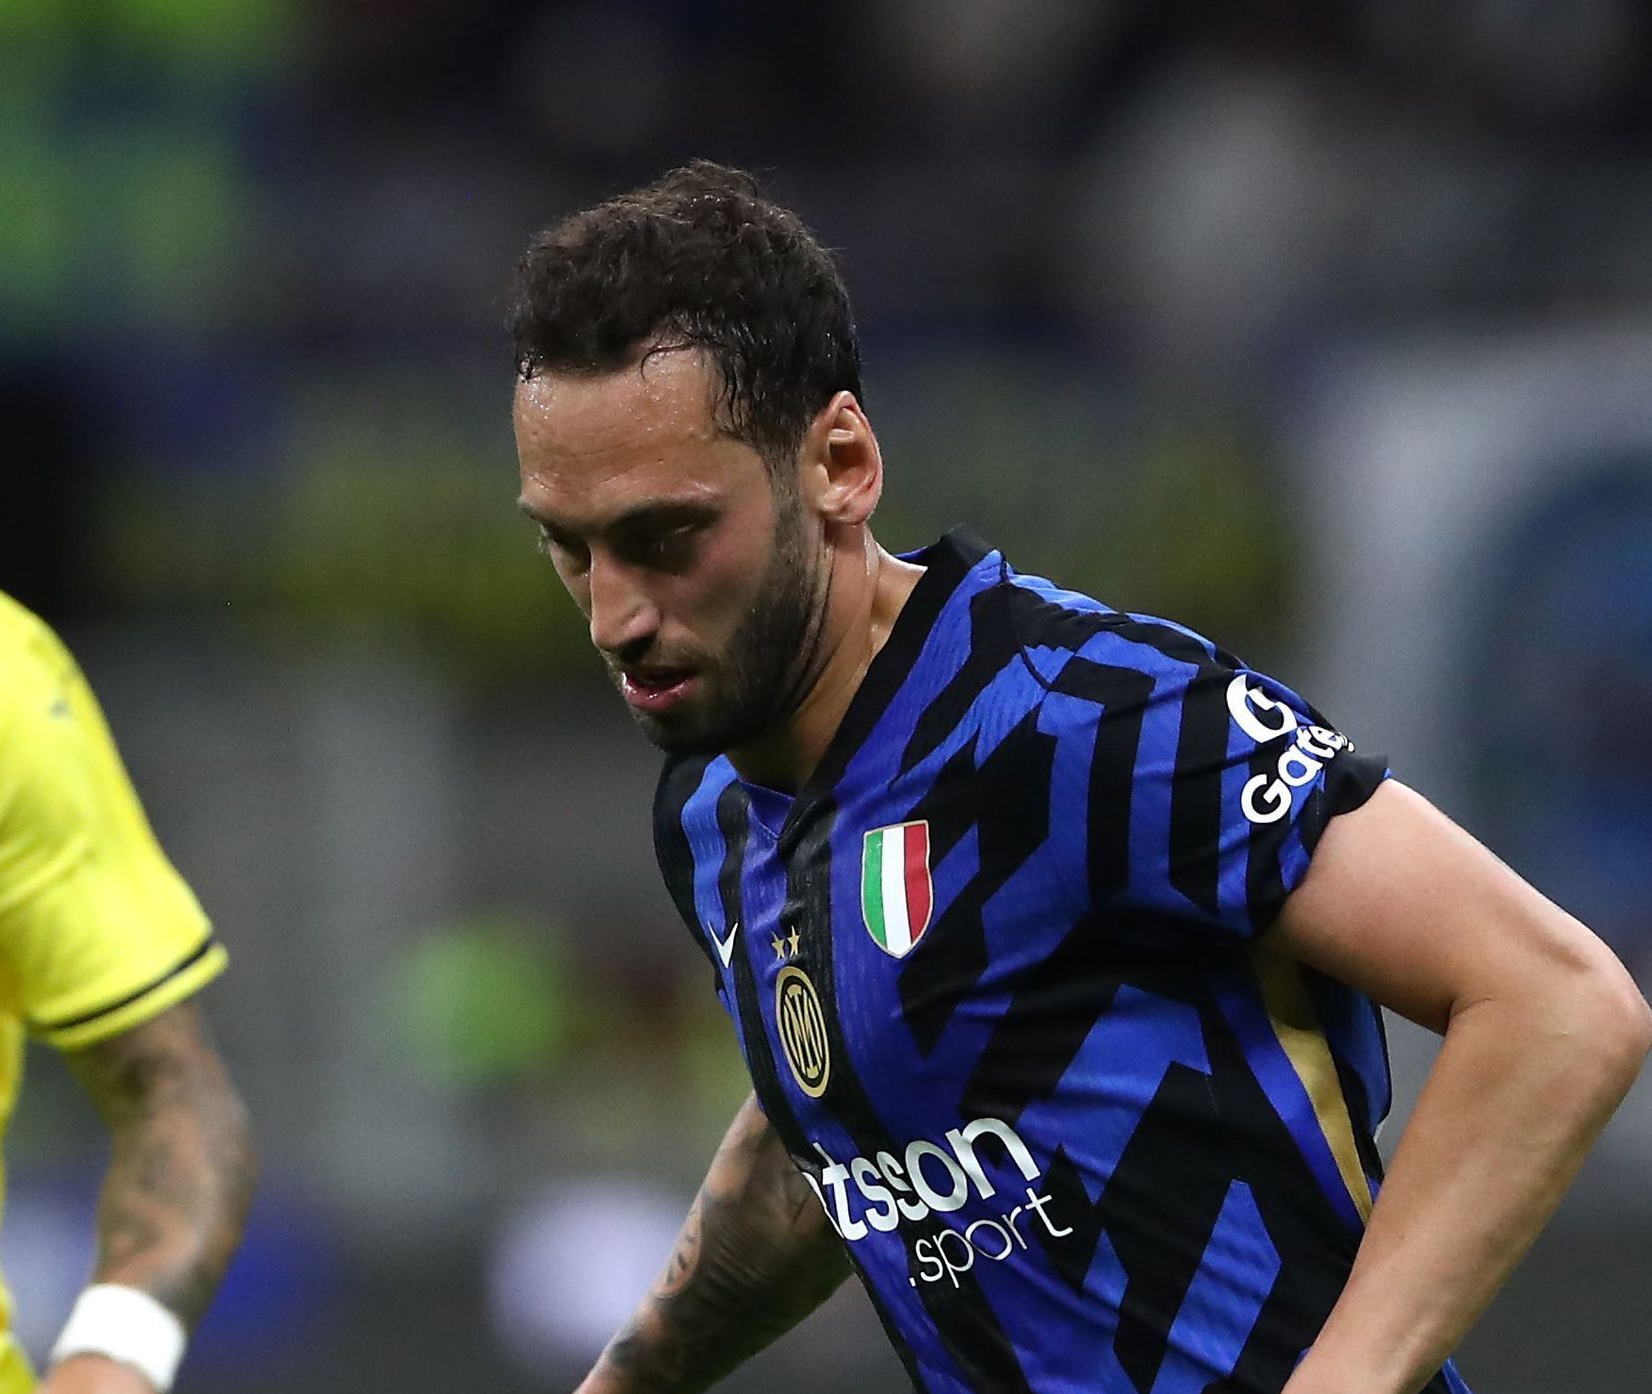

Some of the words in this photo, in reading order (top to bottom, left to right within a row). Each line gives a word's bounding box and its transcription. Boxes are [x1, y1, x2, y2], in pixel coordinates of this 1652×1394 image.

[1241, 725, 1355, 823] Gate
[802, 1118, 1041, 1241] tsson
[909, 1187, 1074, 1288] .sport
